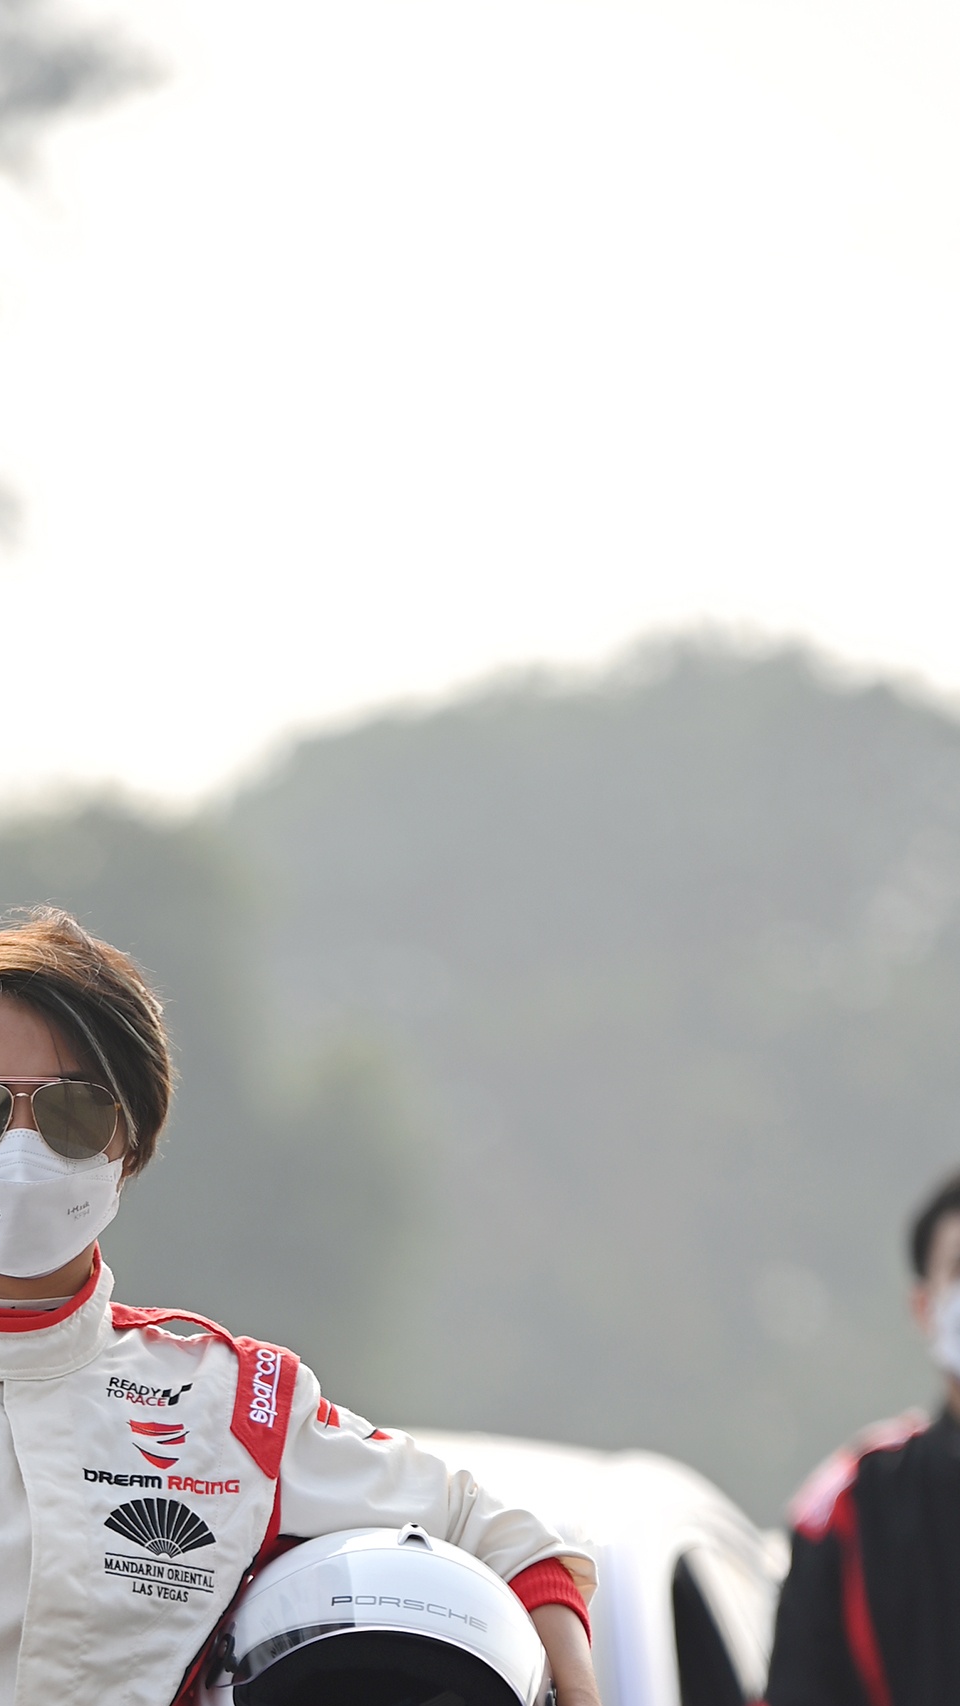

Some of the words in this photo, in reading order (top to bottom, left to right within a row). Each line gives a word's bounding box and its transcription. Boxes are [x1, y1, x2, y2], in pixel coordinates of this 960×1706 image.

[106, 1387, 125, 1399] TO
[125, 1391, 167, 1407] RACE
[108, 1376, 162, 1397] READY
[249, 1348, 278, 1426] sparco
[82, 1467, 163, 1490] DREAM
[167, 1475, 241, 1495] RACING
[104, 1557, 165, 1579] MANDARIN
[167, 1568, 215, 1588] ORIENTAL
[132, 1581, 153, 1597] LAS
[156, 1585, 190, 1603] VEGAS
[331, 1595, 489, 1633] PORSCHE
